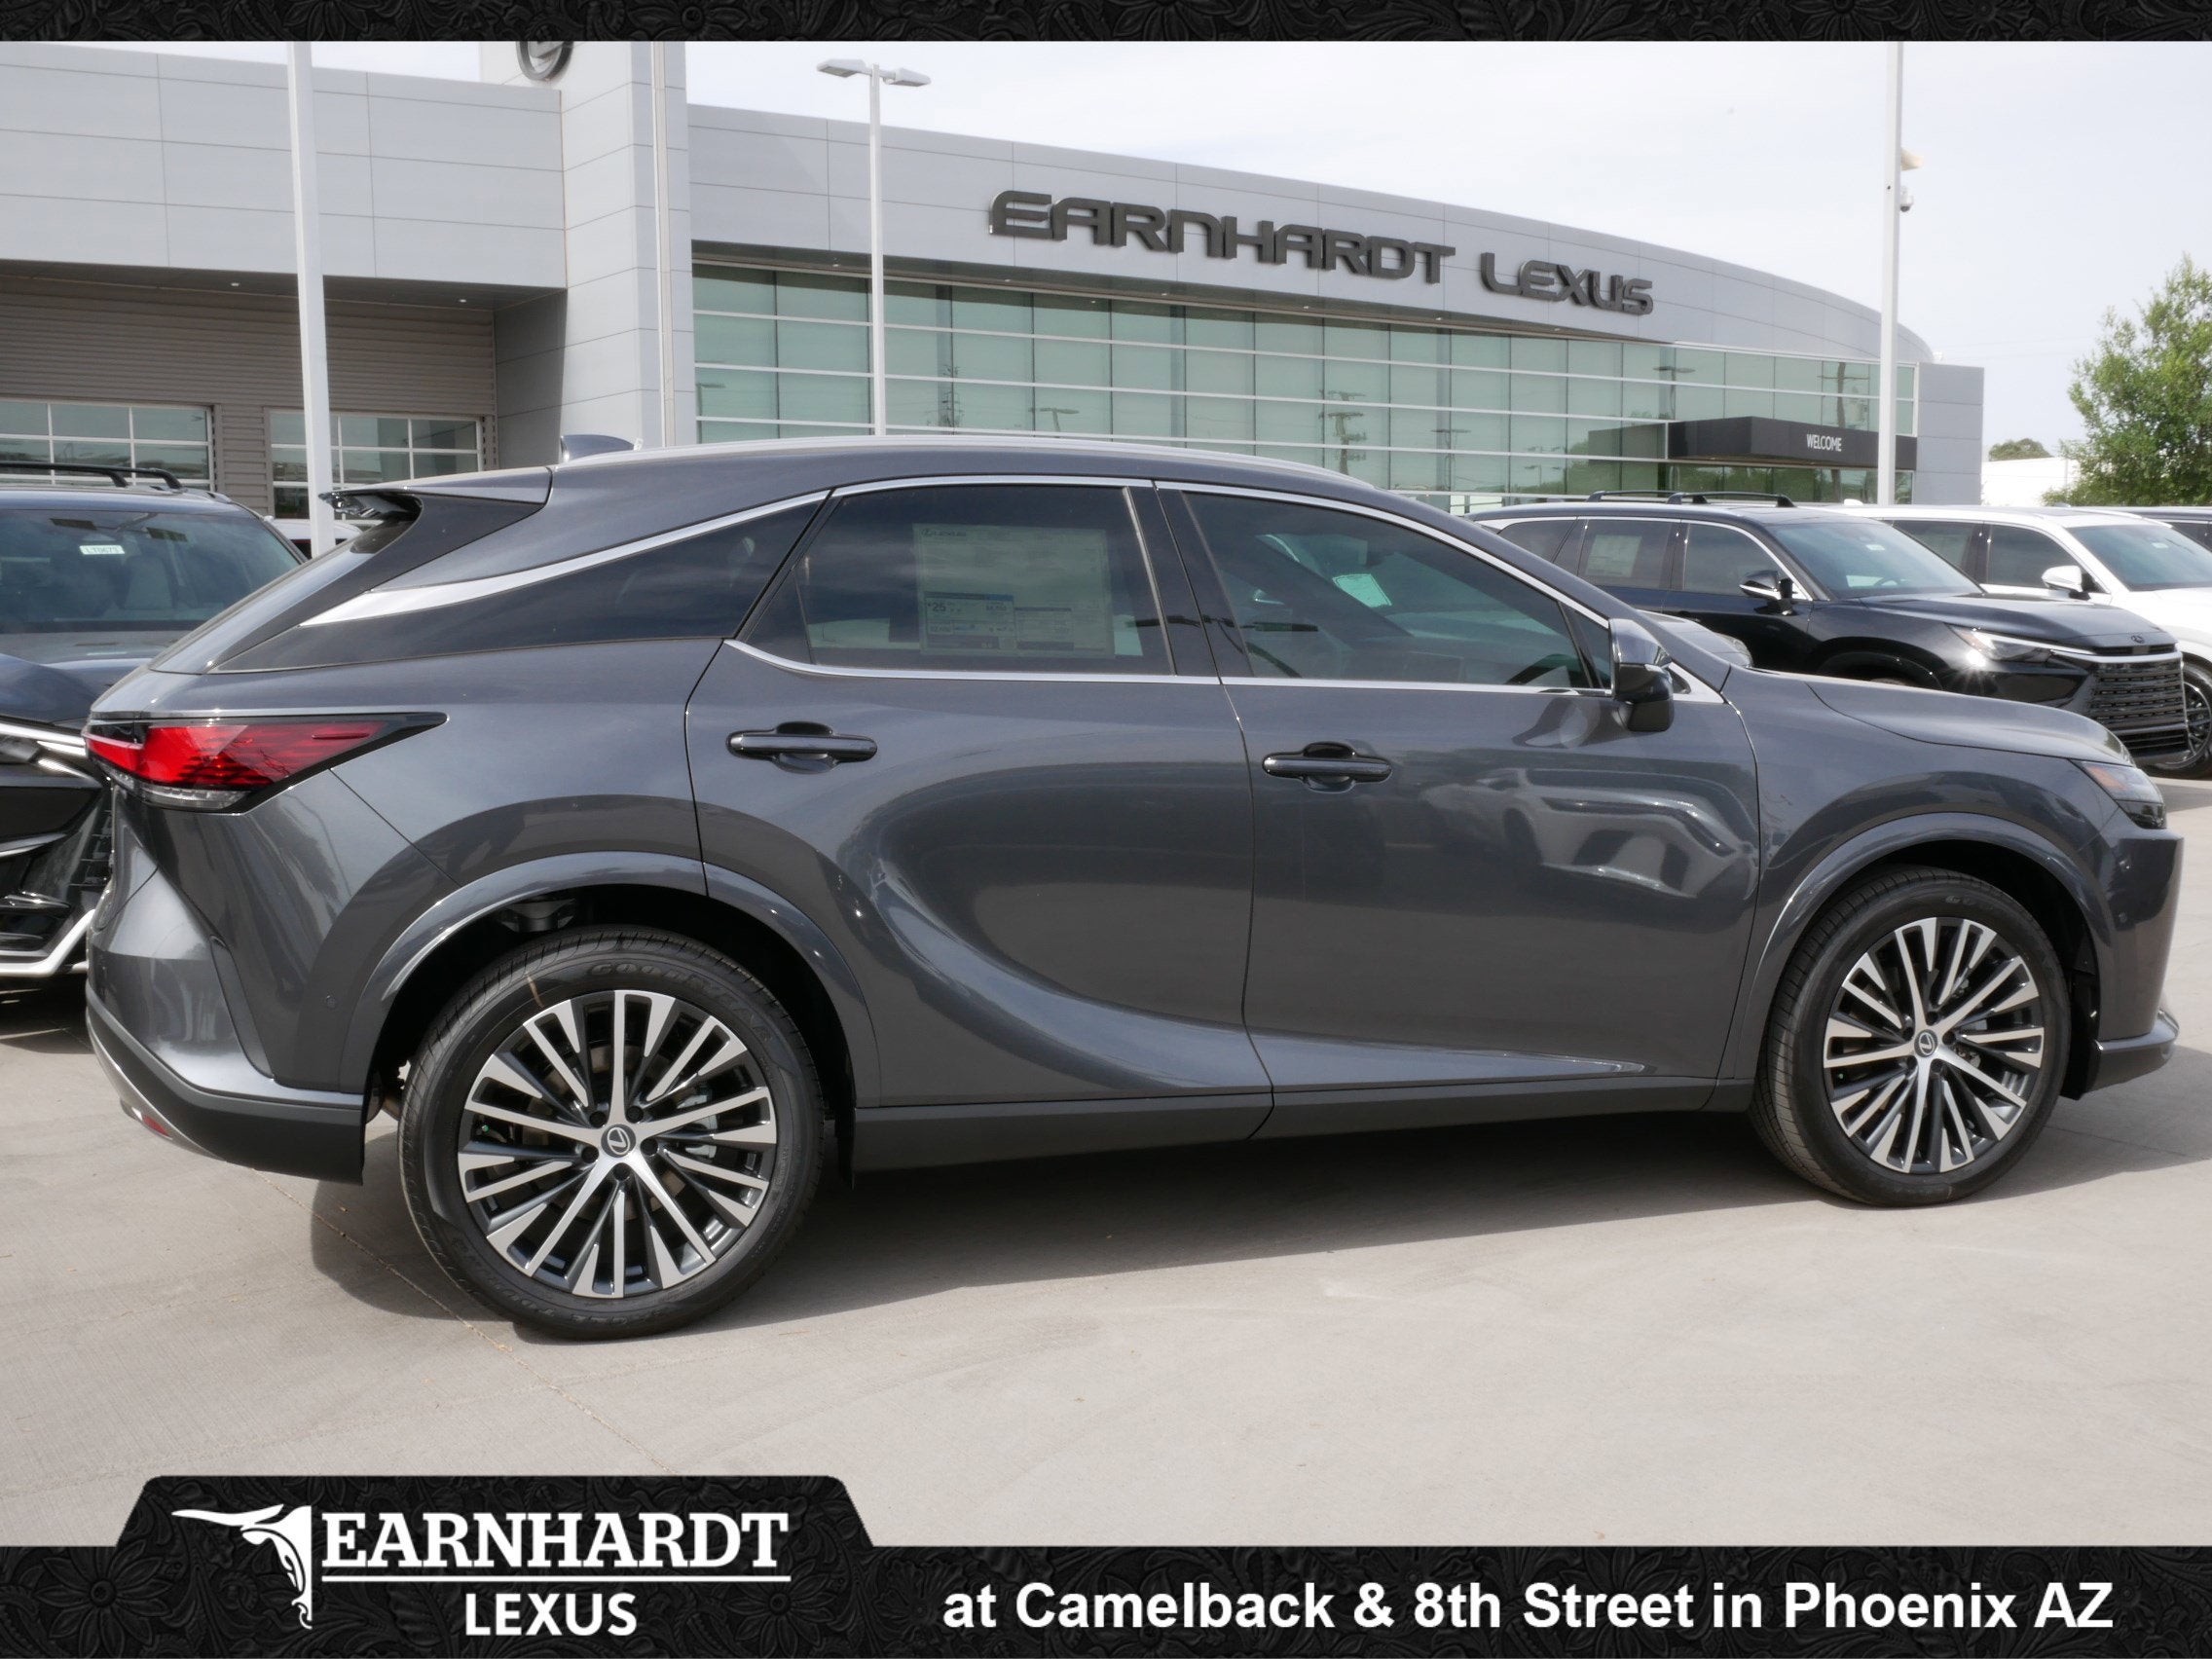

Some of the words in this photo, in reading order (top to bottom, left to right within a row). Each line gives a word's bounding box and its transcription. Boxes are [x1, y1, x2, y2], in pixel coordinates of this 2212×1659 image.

[988, 190, 1456, 284] EARNHARDT
[1481, 251, 1653, 315] LEXUS
[1806, 433, 1842, 452] WELCOME
